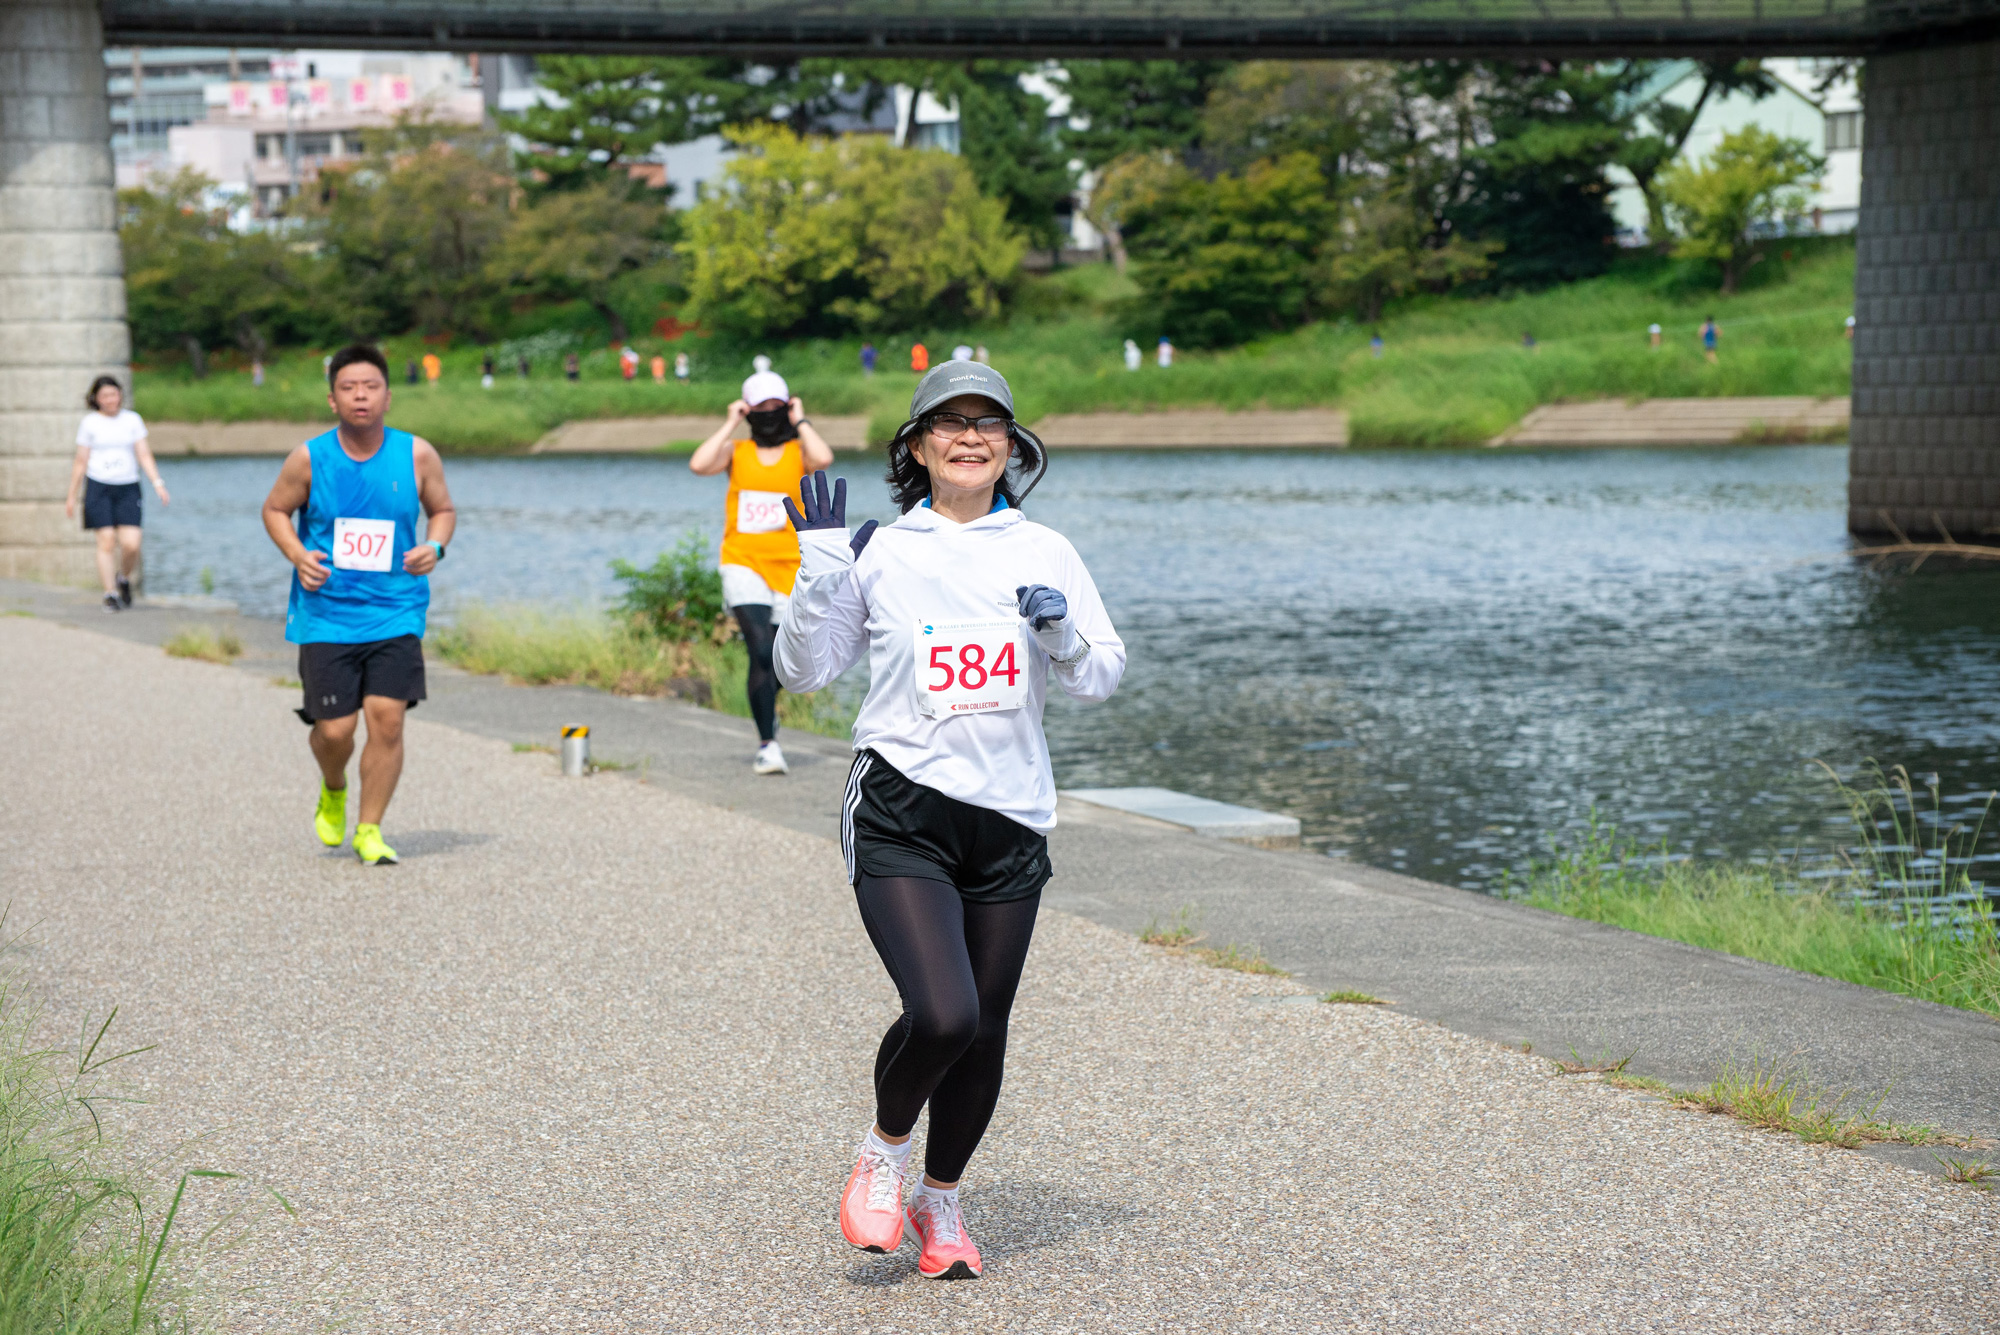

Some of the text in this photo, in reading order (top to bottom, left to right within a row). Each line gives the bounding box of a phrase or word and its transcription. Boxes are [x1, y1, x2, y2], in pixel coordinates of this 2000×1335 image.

[745, 502, 781, 525] 595
[341, 532, 387, 557] 507
[928, 642, 1021, 692] 584
[958, 701, 999, 711] RUN COLLECTION
